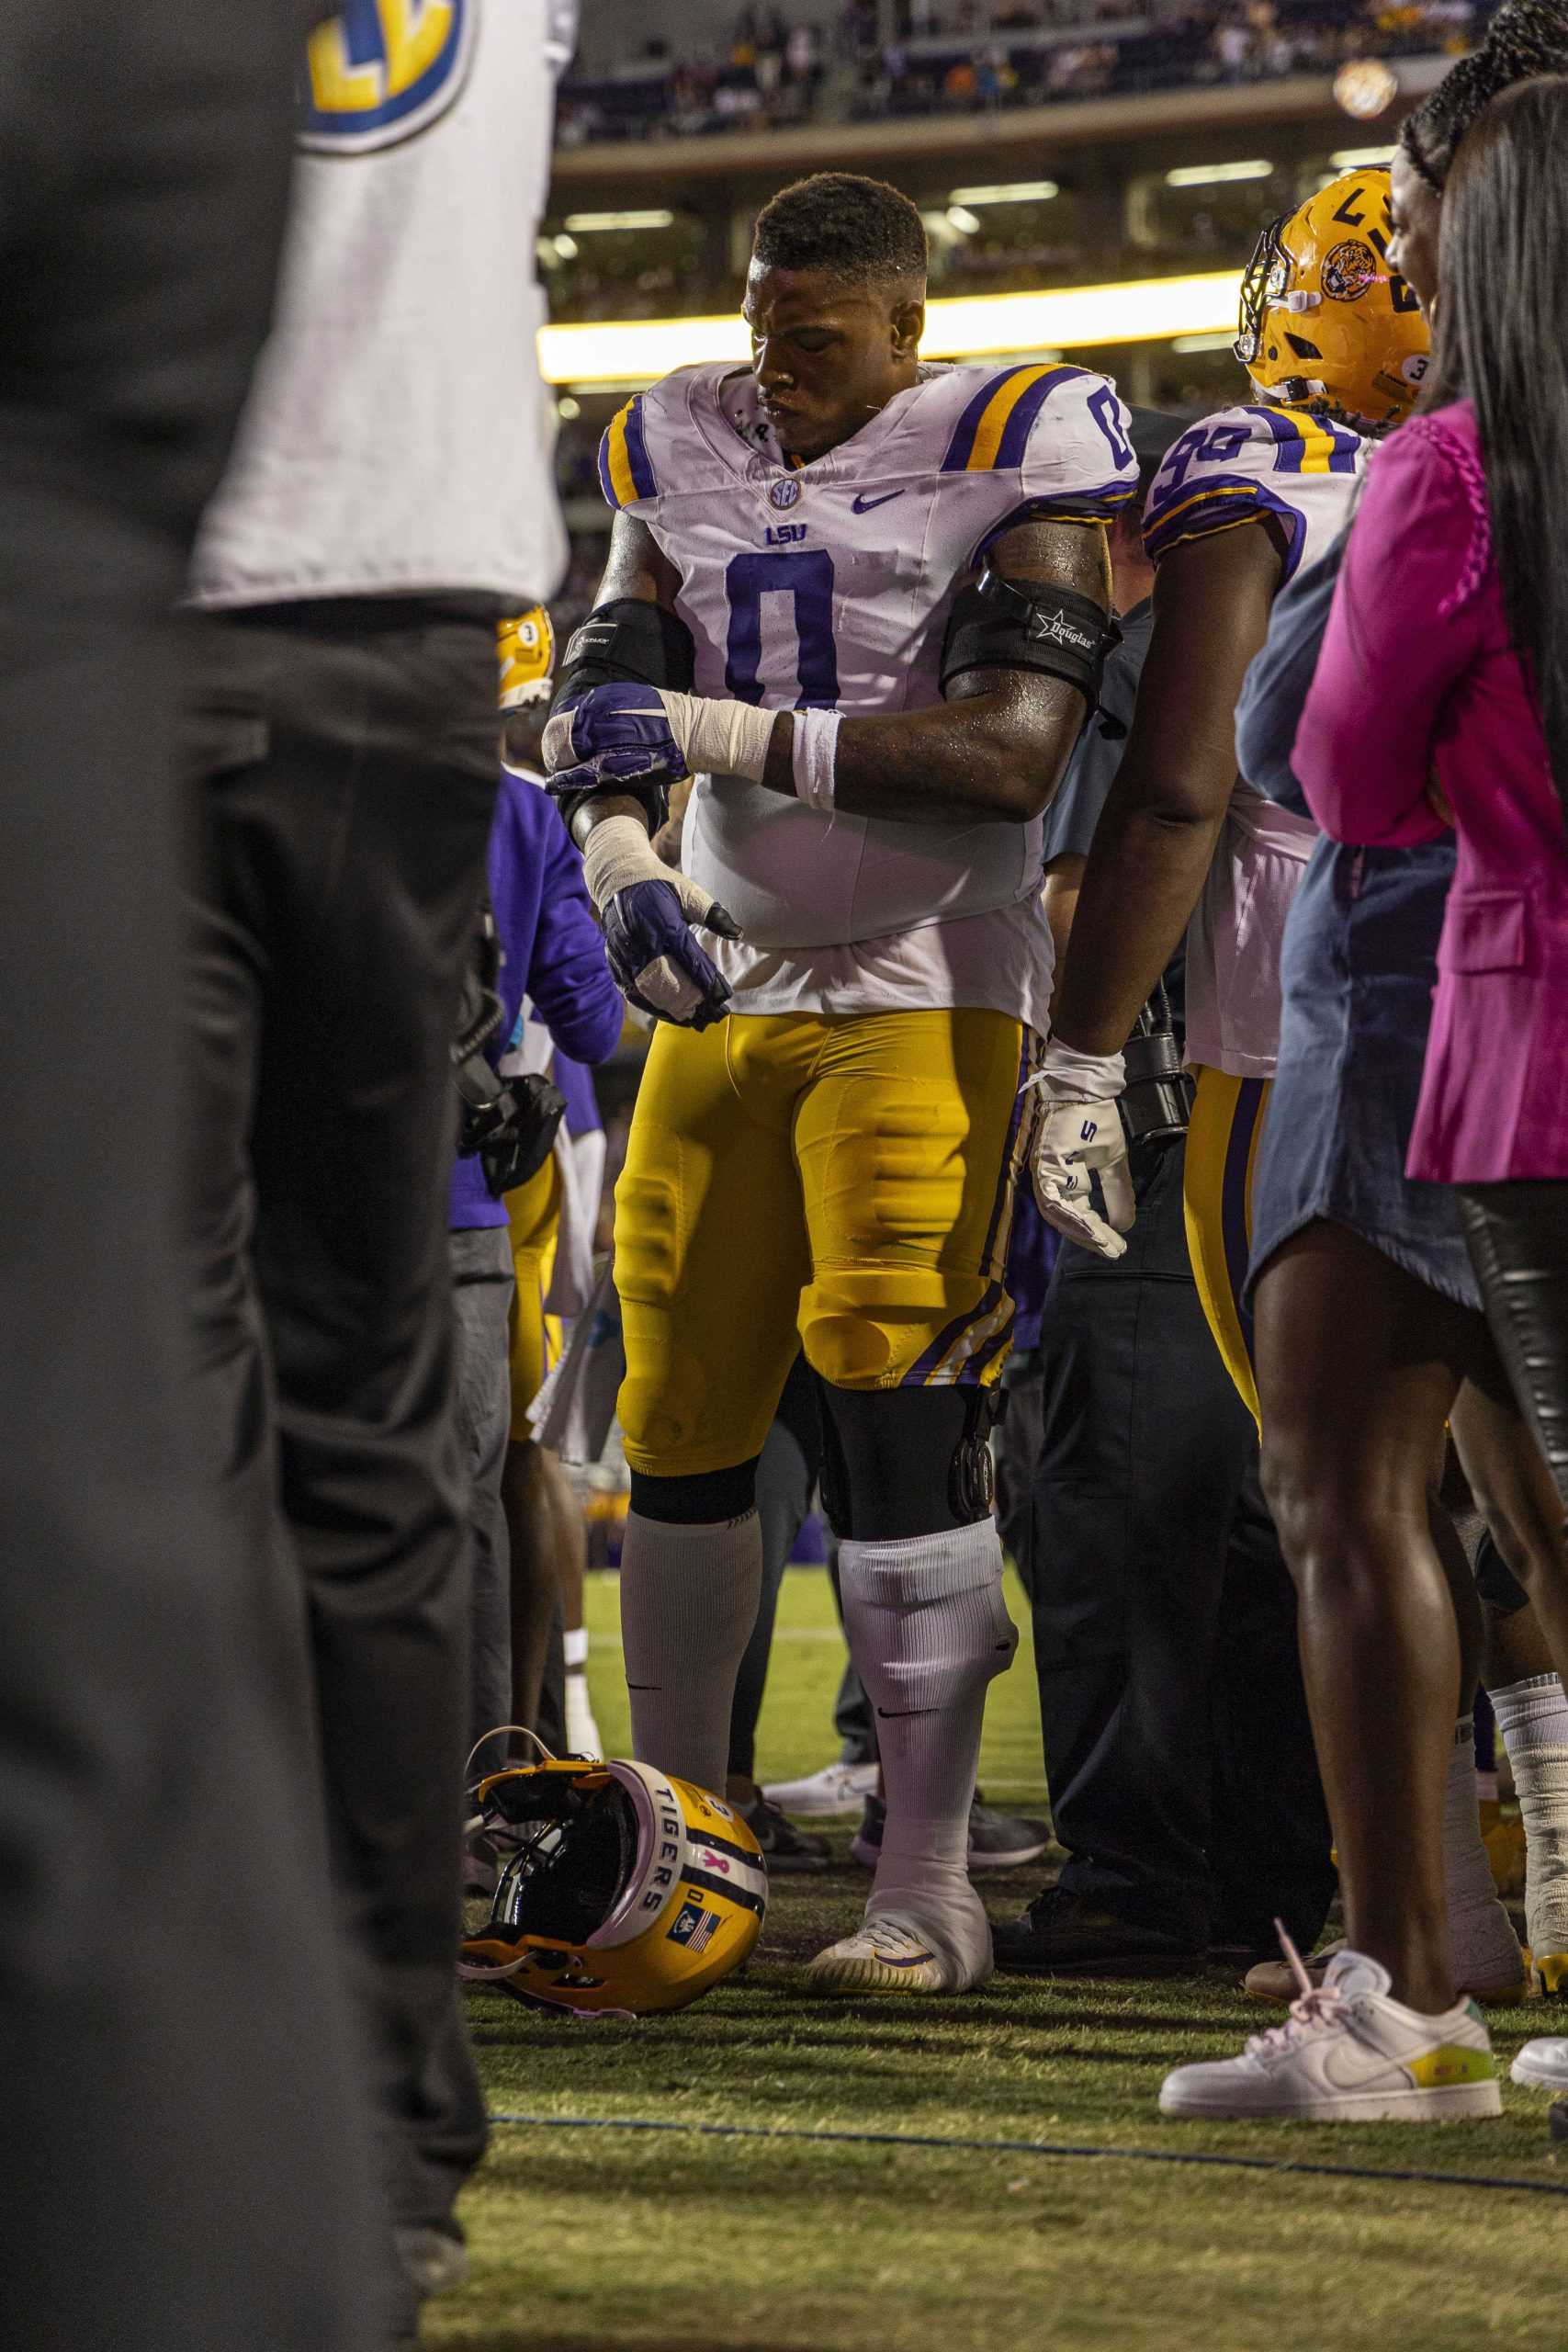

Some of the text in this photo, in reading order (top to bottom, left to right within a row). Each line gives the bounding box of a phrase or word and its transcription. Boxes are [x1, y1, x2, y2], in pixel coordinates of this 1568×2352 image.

[1087, 385, 1134, 472] 0
[764, 524, 807, 545] LSU
[725, 548, 841, 710] 0
[1050, 621, 1092, 649] Douglas
[638, 1788, 680, 1913] TIGERS
